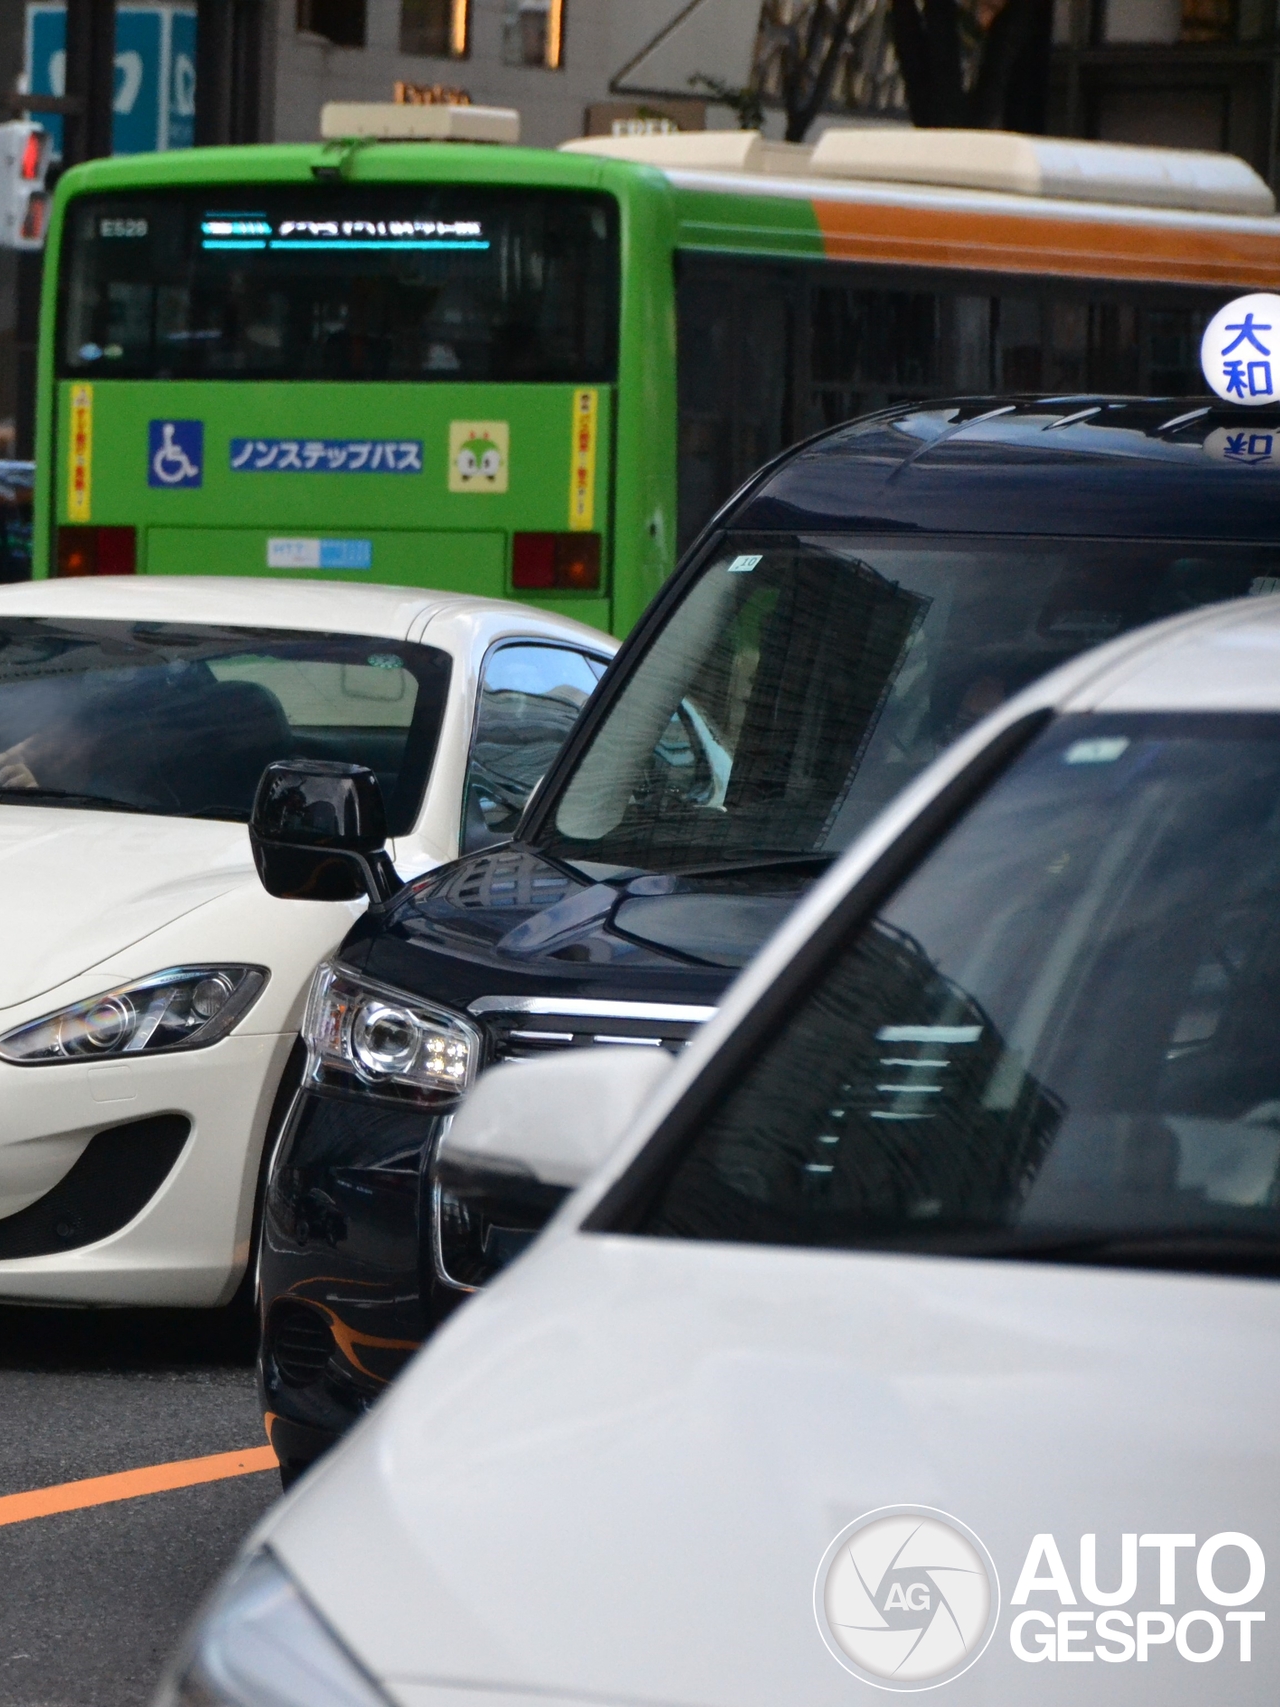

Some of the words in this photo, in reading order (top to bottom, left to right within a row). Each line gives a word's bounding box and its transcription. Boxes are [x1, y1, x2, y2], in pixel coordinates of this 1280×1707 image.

[1221, 312, 1274, 399] 大和
[231, 441, 422, 470] ノンステップバス
